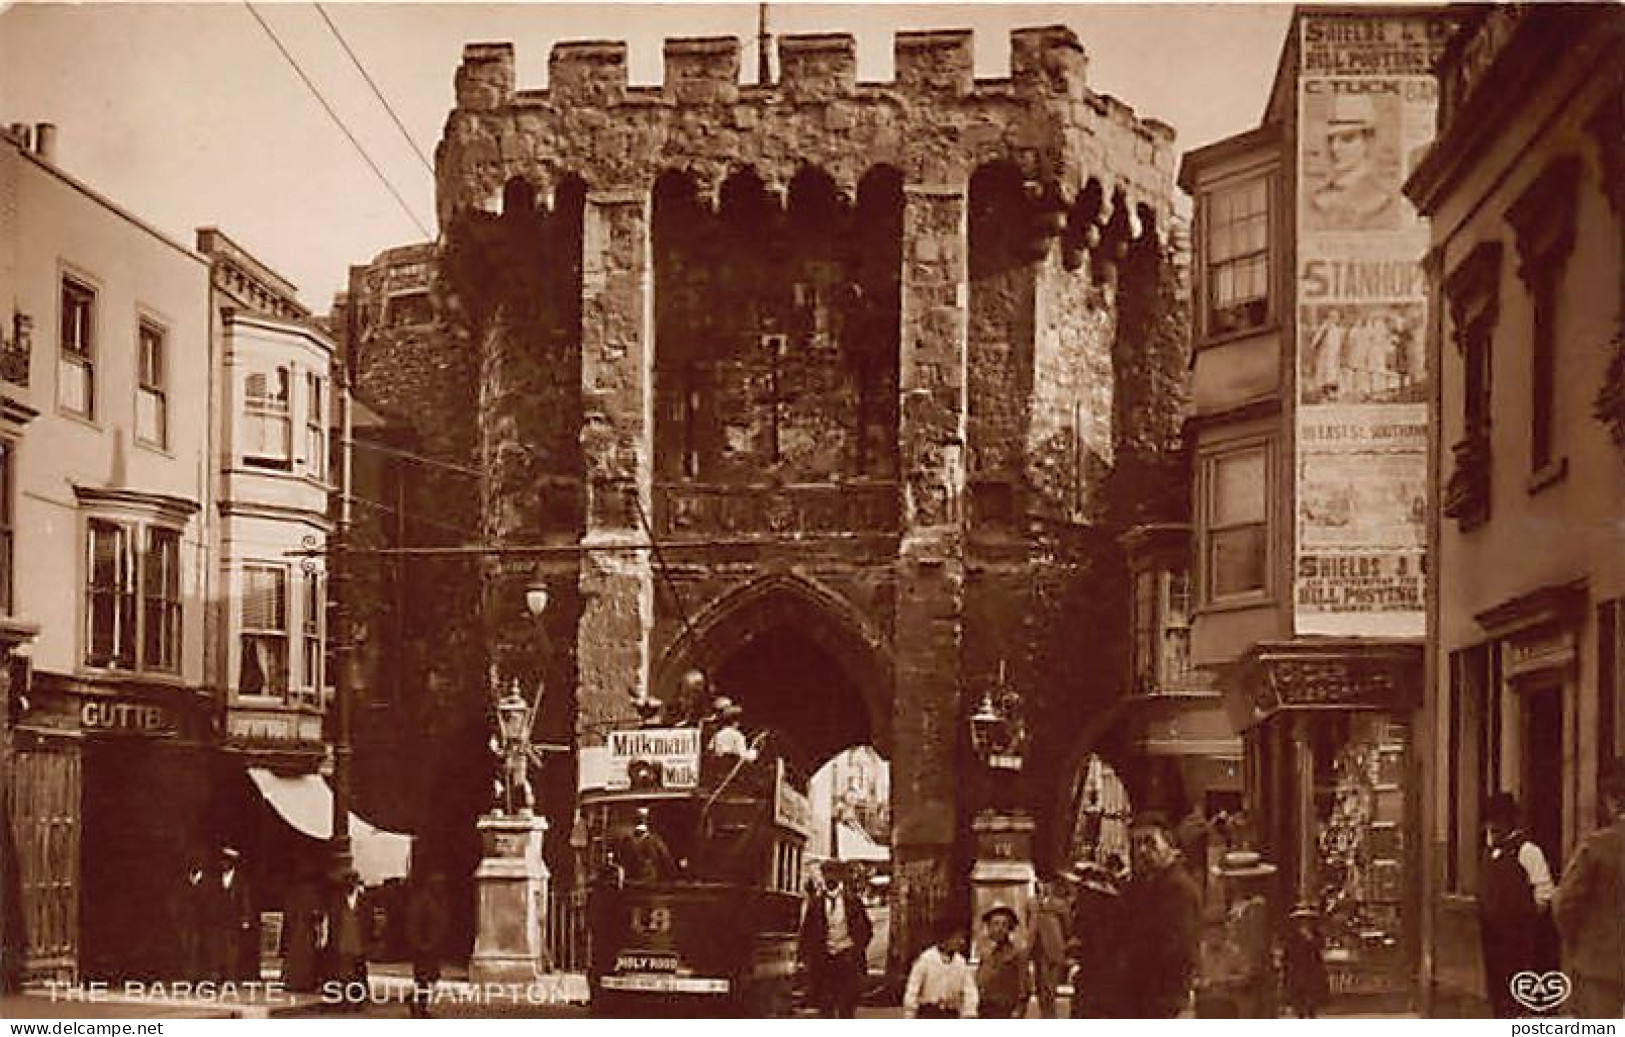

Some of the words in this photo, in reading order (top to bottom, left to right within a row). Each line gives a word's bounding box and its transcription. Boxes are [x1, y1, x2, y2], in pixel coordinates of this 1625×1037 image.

[1299, 555, 1380, 577] SHIELDS
[1299, 587, 1340, 605] BILL
[1343, 586, 1418, 604] POSTING
[612, 732, 697, 757] Milkmaid
[664, 766, 697, 784] Milk
